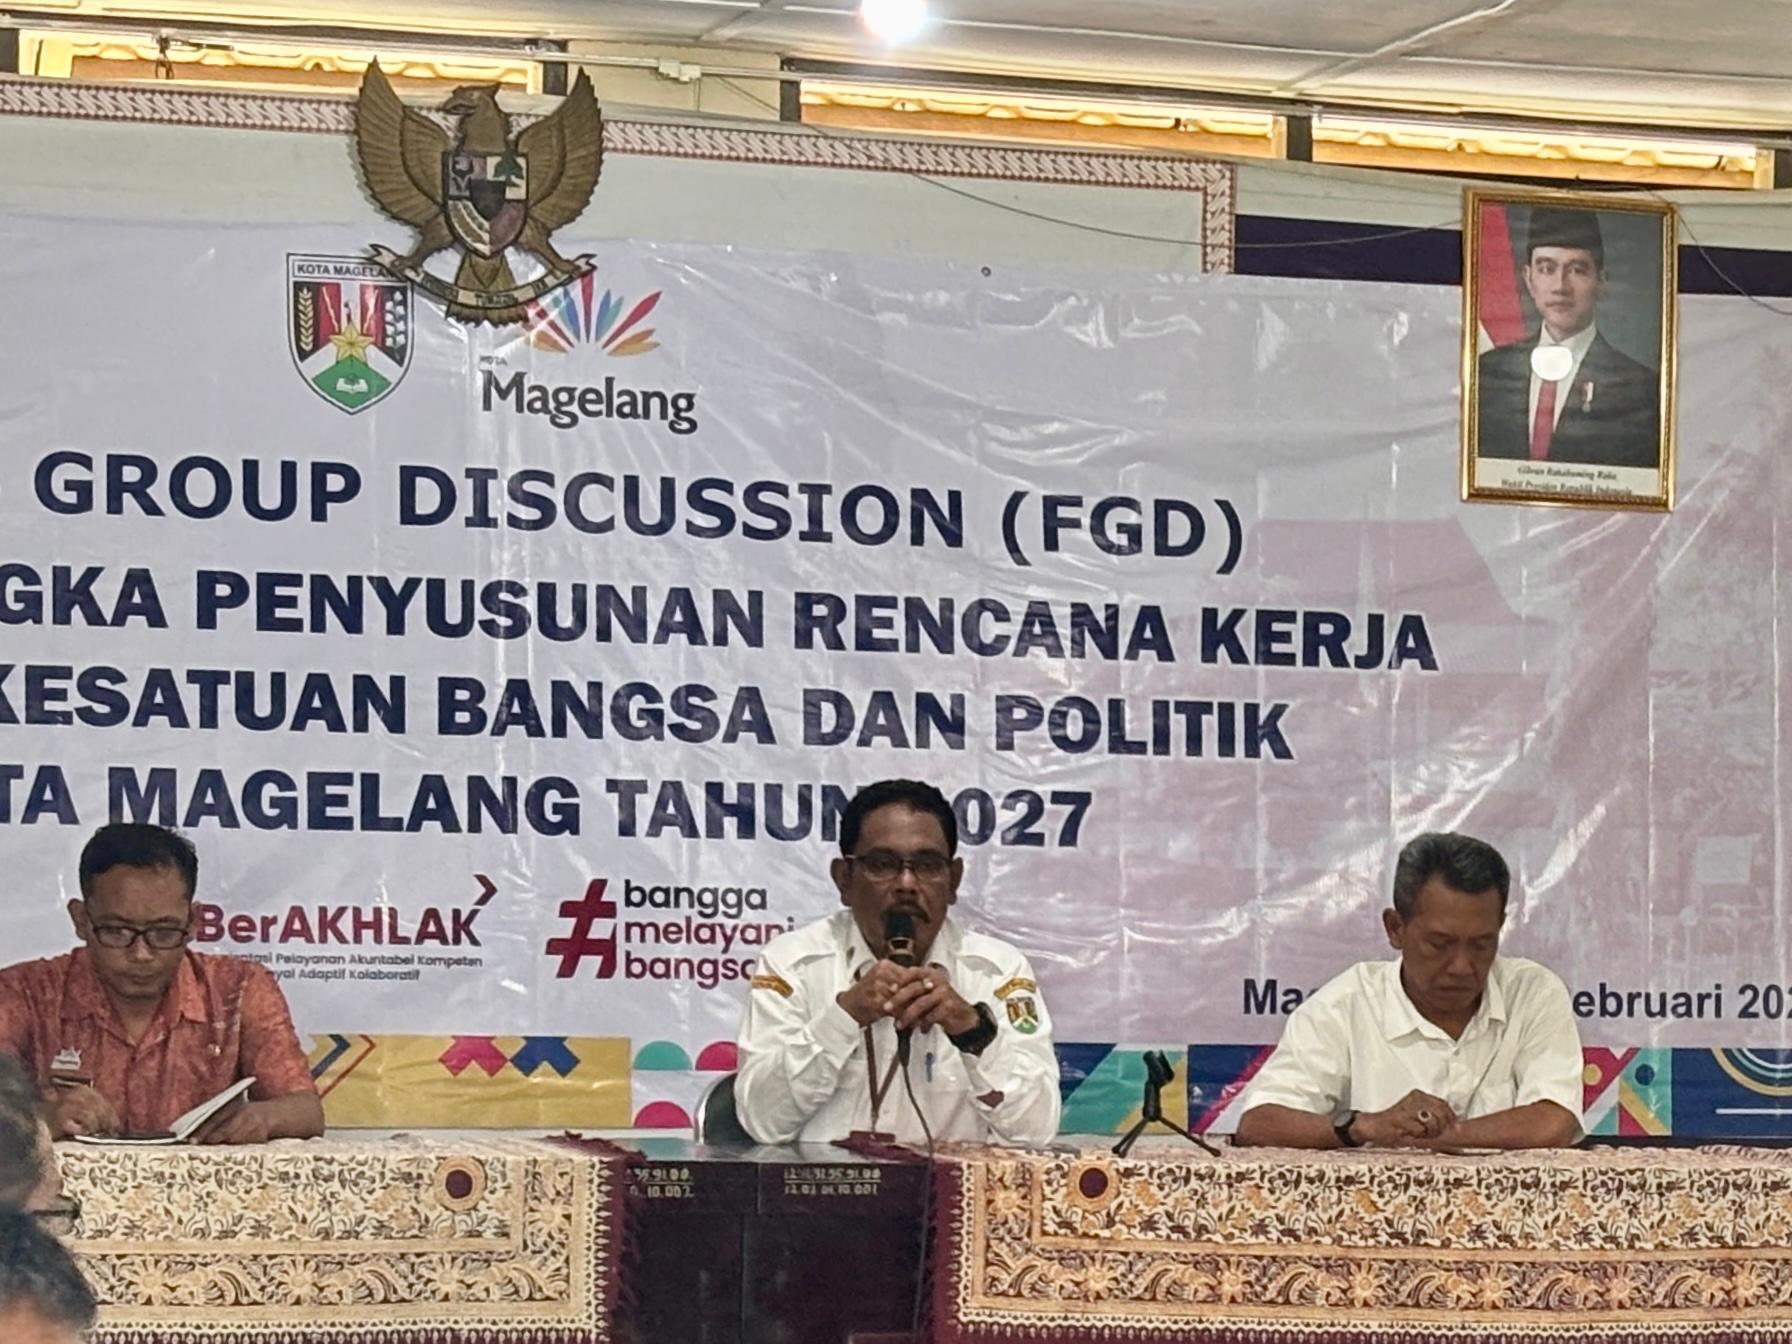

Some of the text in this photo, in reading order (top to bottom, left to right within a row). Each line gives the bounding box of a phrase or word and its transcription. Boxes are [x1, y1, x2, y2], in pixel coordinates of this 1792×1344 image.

[296, 262, 392, 277] KOTA MAGELA
[480, 369, 698, 435] Magelang
[35, 451, 1242, 574] GROUP DISCUSSION (FGD)
[197, 570, 763, 648] PENYUSUNAN
[795, 592, 1175, 662] RENCANA
[1201, 608, 1438, 670] KERJA
[438, 677, 776, 744] BANGSA
[803, 689, 965, 750] DAN
[996, 695, 1293, 759] POLITIK
[107, 766, 581, 838] MAGELANG
[950, 787, 1093, 848] 027
[625, 879, 767, 919] bangga
[197, 905, 481, 946] BerAKHLAK
[275, 953, 346, 968] Pelayanan
[349, 954, 415, 966] Akuntabel
[417, 955, 483, 968] Kompeten
[299, 969, 346, 982] Adaptif
[1572, 983, 1722, 1018] ebruari
